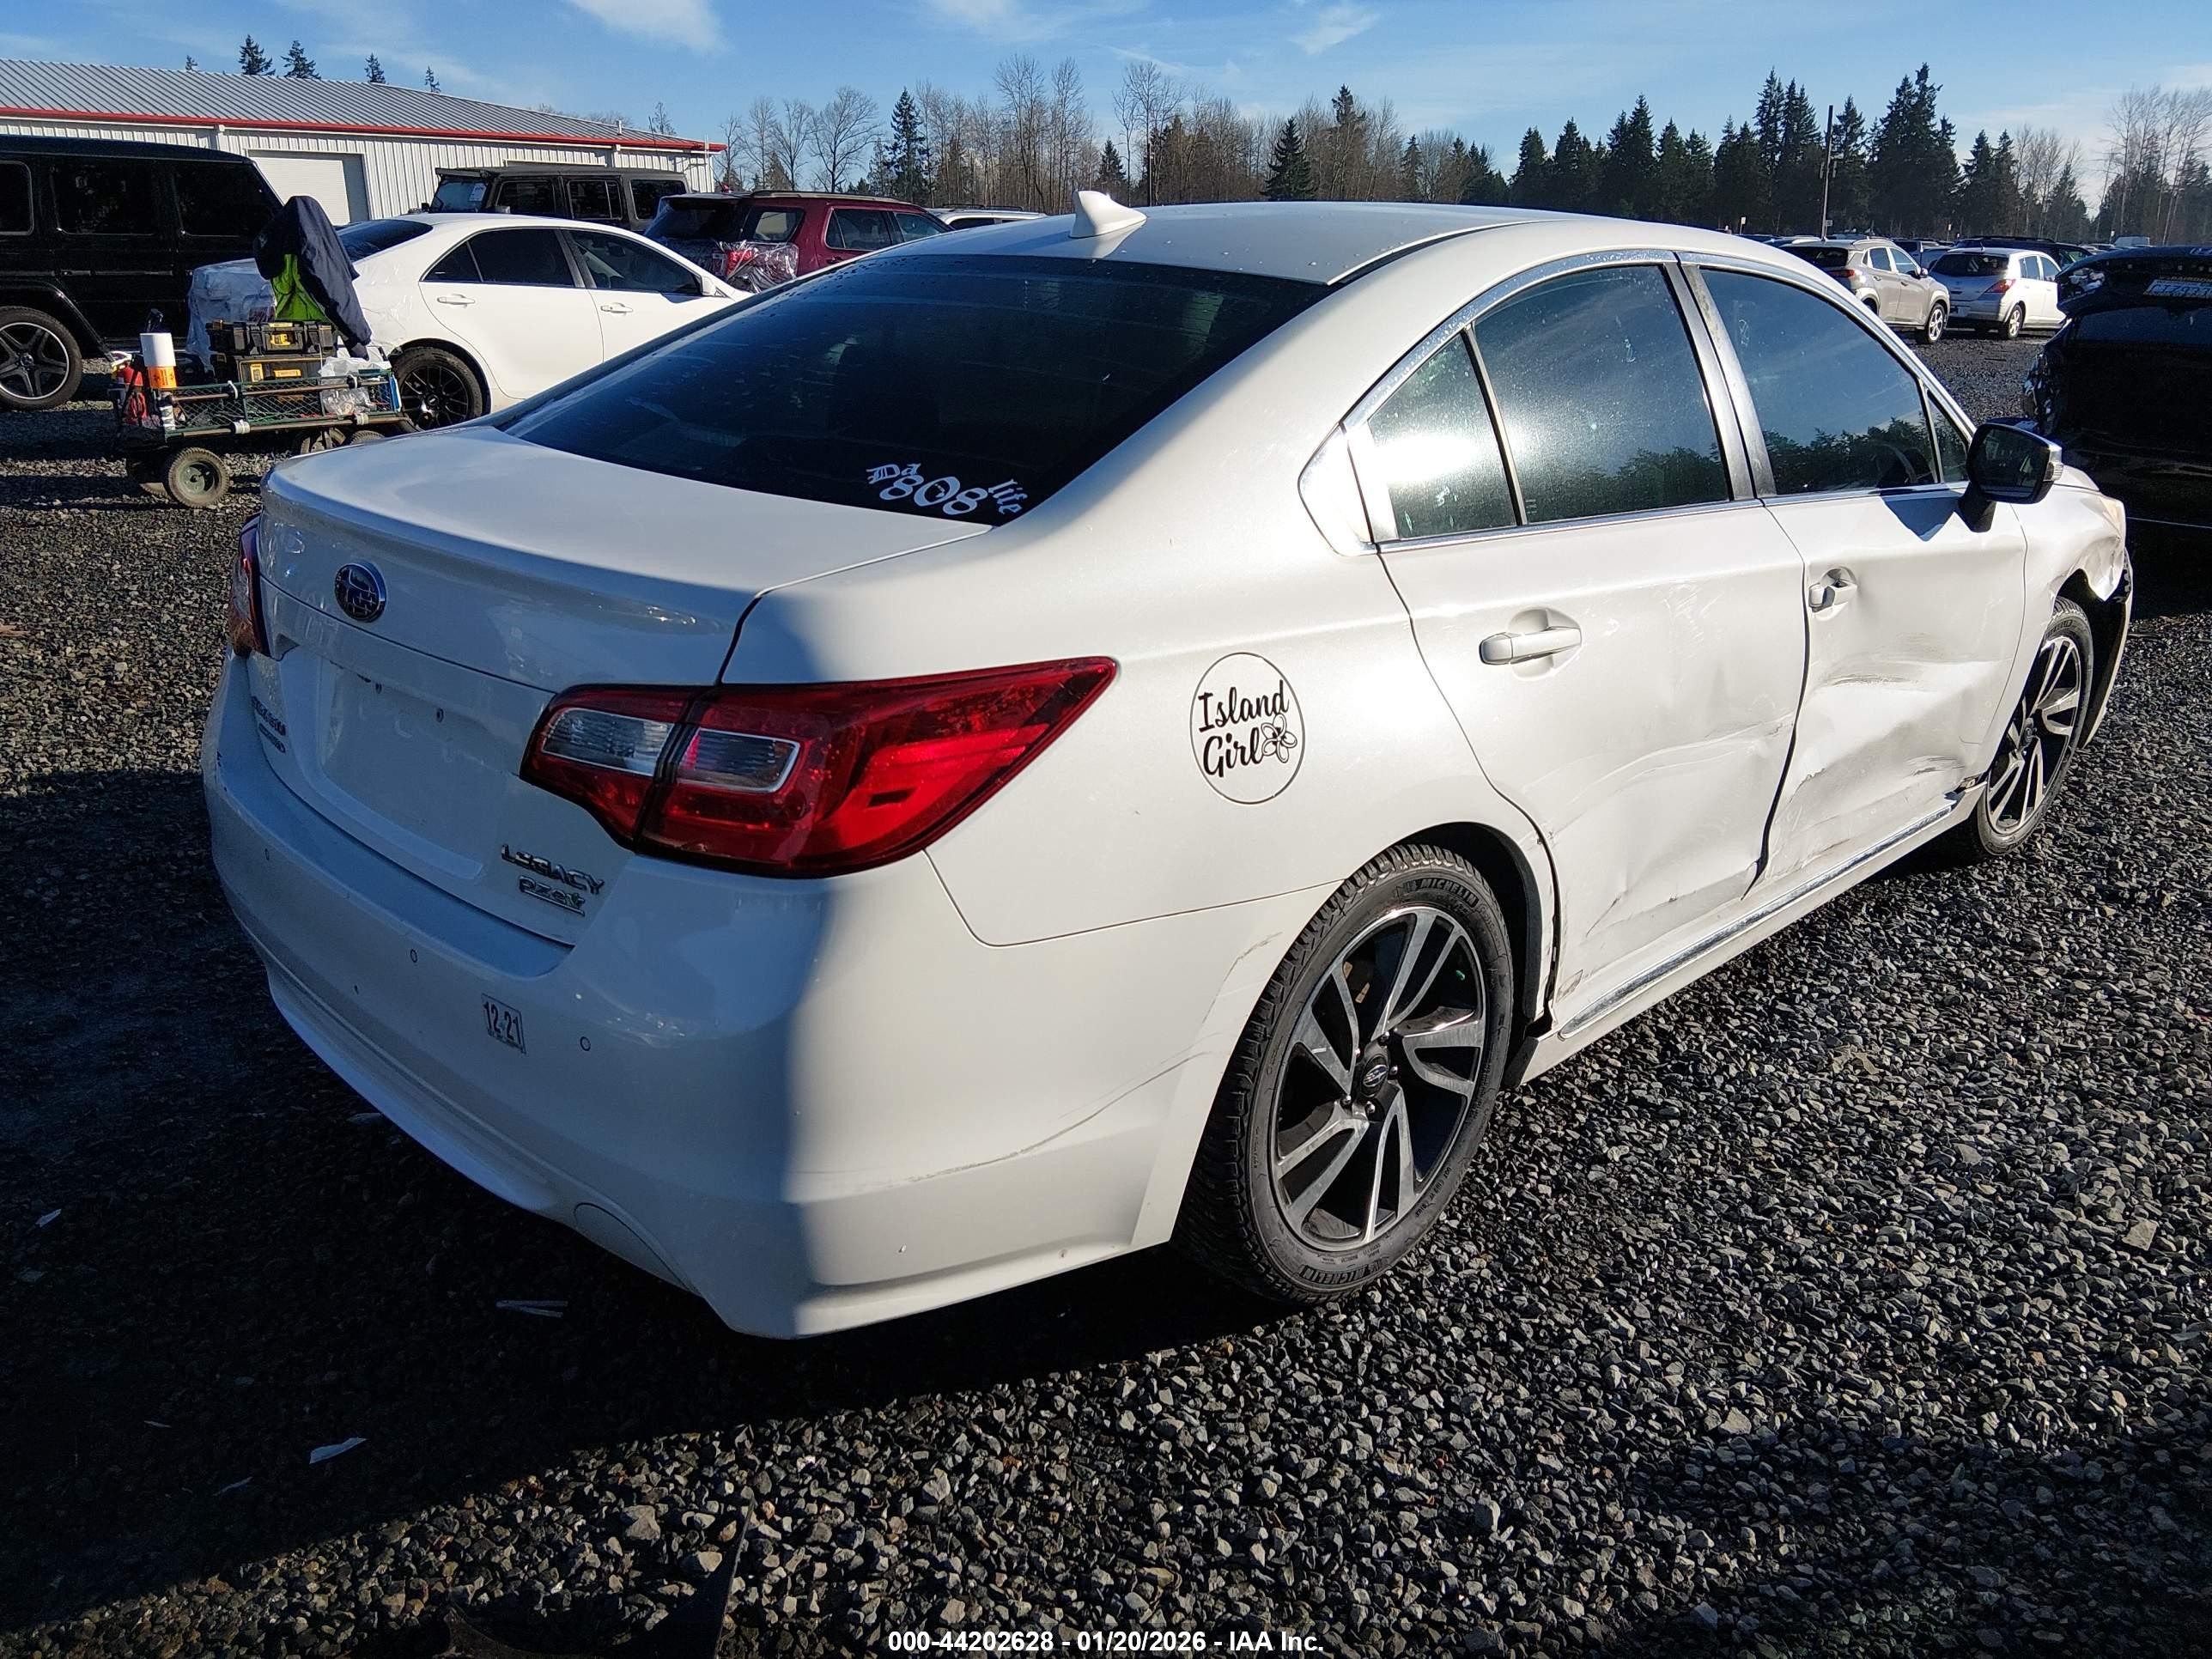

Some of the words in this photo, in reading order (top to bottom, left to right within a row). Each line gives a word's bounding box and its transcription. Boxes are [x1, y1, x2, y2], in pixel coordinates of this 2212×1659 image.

[866, 463, 921, 484] Da
[878, 475, 988, 515] 808
[1198, 679, 1290, 733] Island
[1203, 726, 1263, 778] Girl
[501, 843, 605, 895] LEGACY
[1420, 878, 1478, 908] MICHELIN
[1303, 1265, 1367, 1285] MICHELIN
